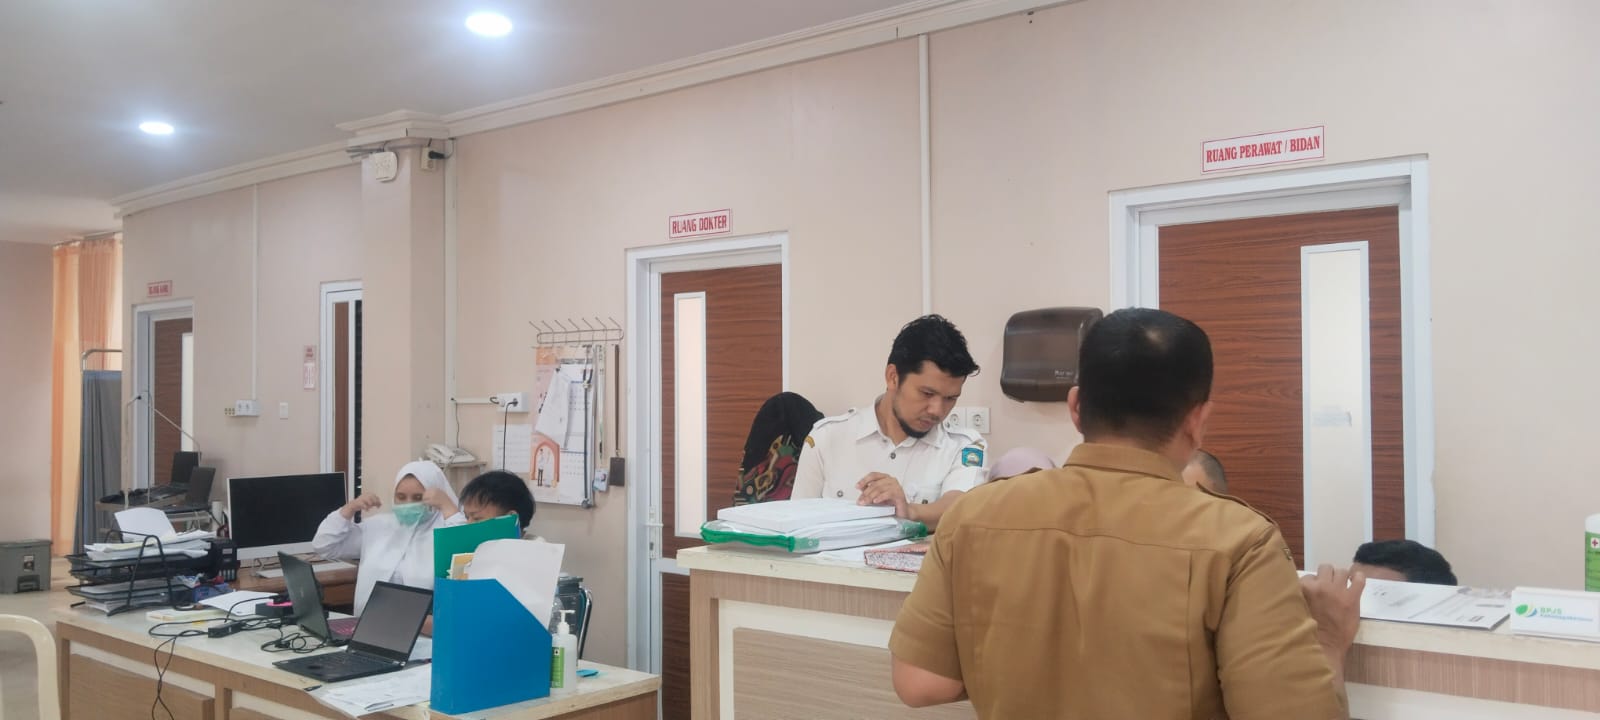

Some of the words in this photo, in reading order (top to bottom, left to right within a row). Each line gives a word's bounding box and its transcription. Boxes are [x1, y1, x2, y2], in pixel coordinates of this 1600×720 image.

[1206, 147, 1237, 163] RUANG
[1239, 141, 1282, 158] PERAWAT
[1290, 136, 1320, 152] BIDAN
[699, 215, 727, 231] DOKTER
